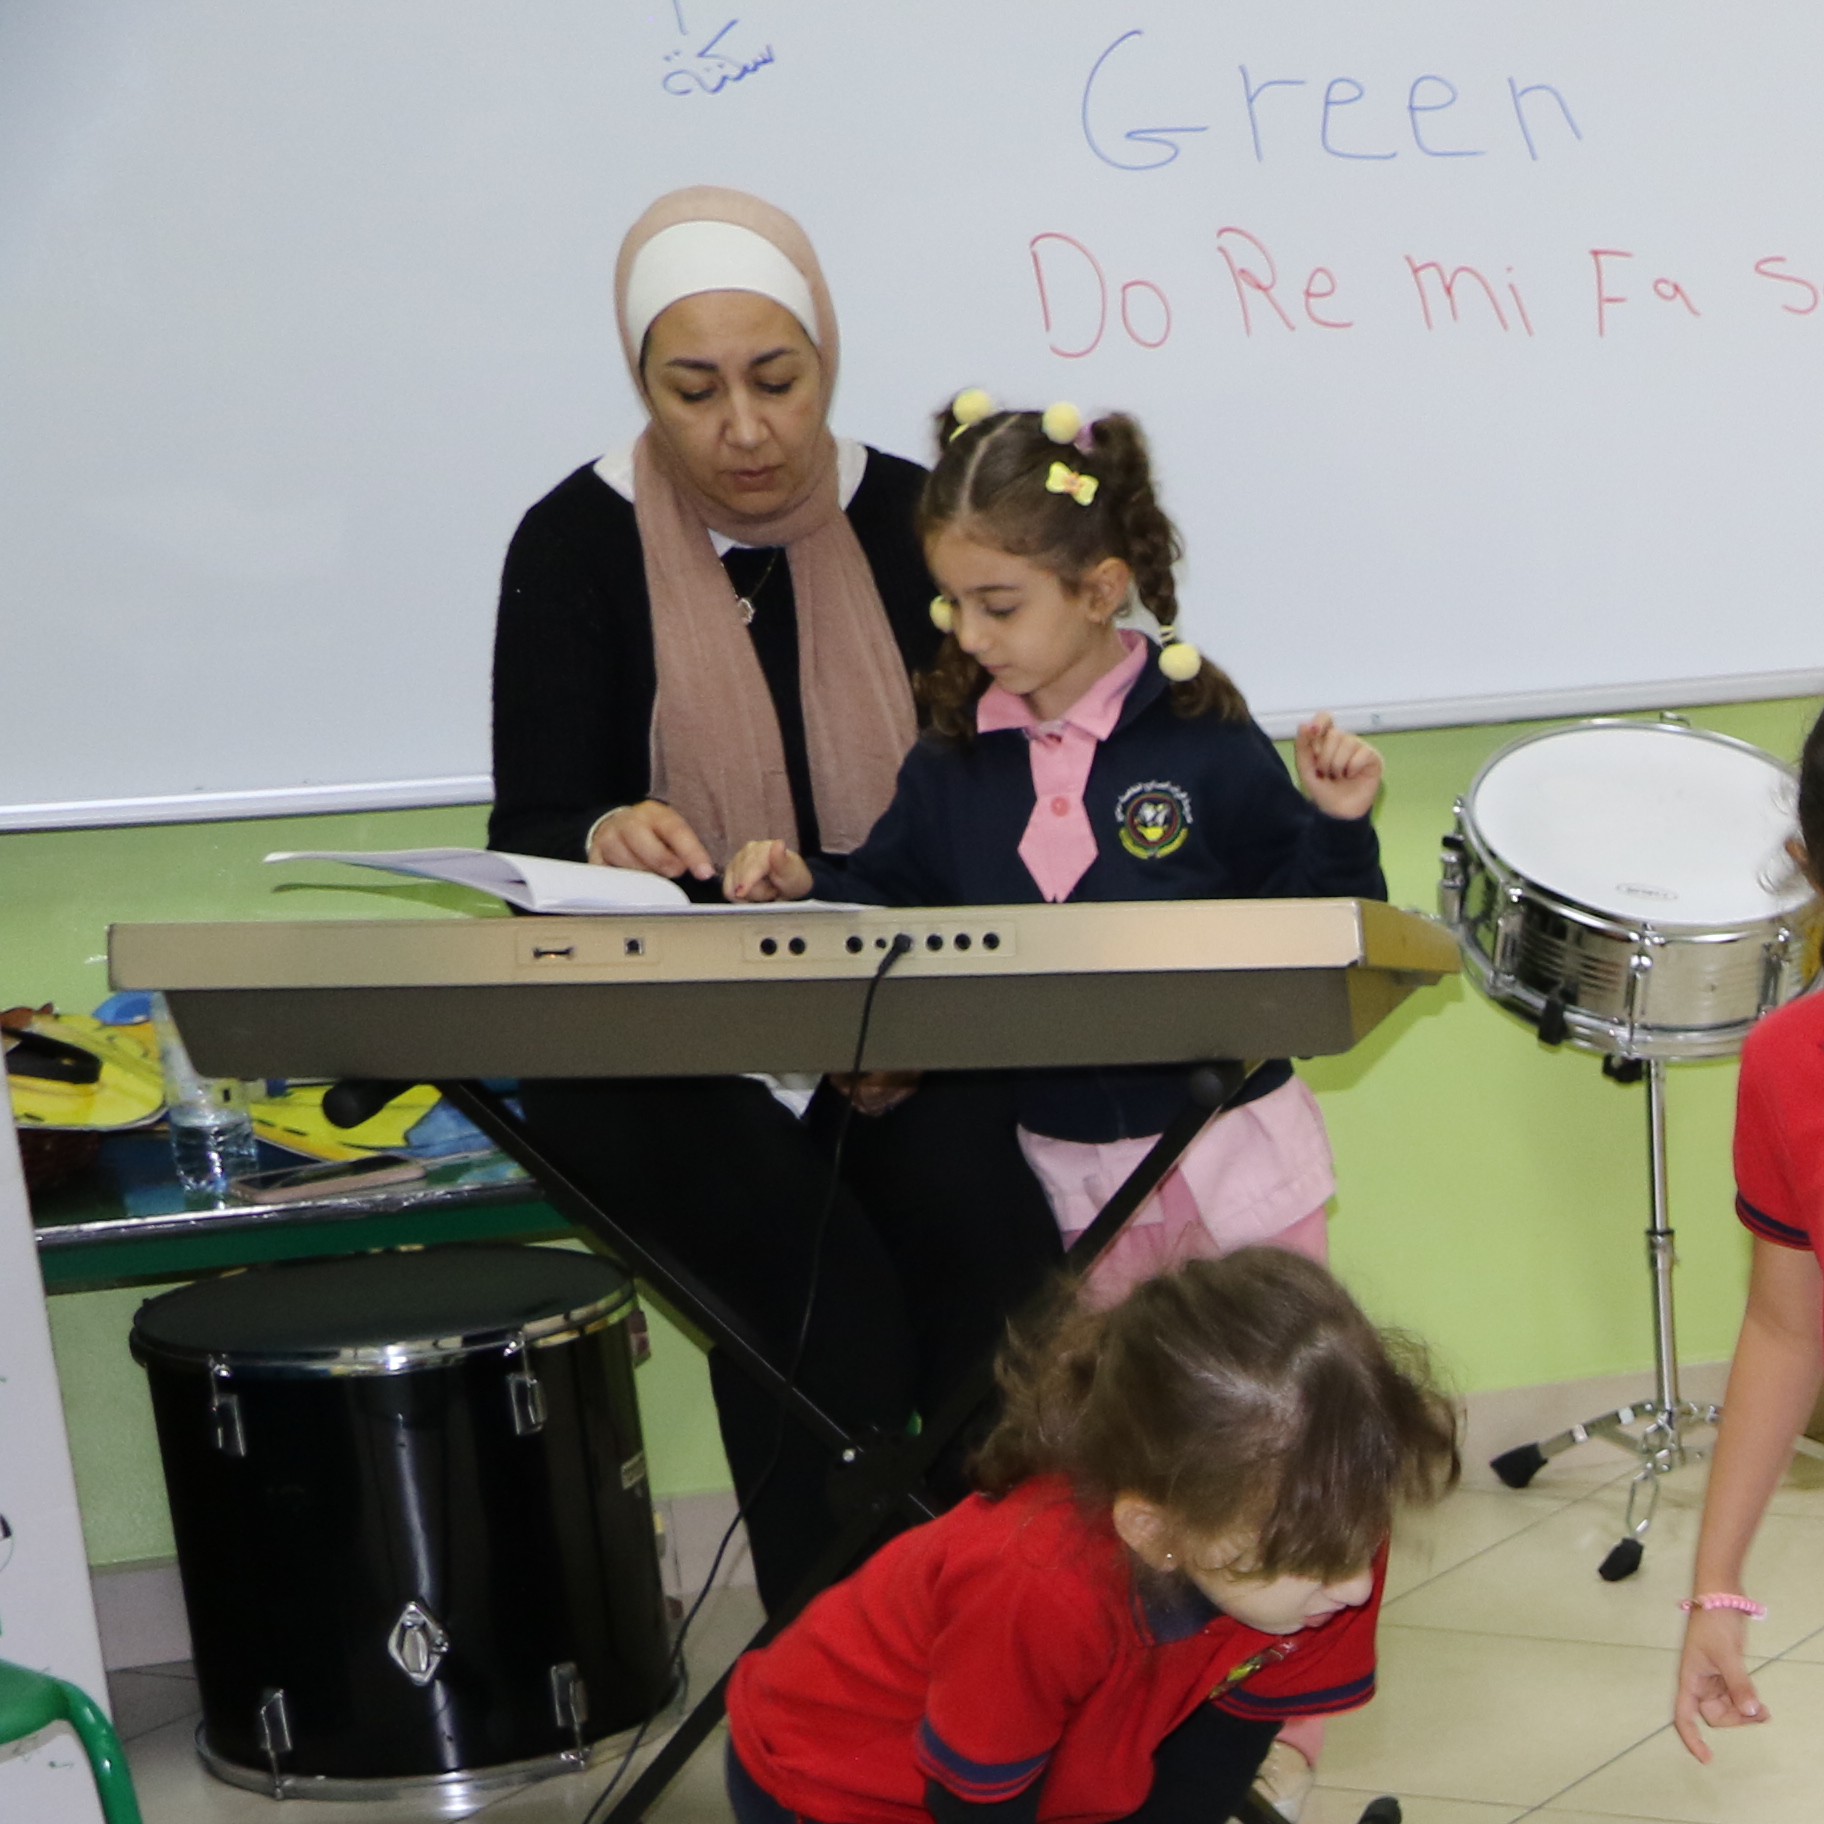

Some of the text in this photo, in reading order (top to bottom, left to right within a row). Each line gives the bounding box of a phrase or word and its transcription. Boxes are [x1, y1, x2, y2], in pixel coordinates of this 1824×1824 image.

[1081, 29, 1582, 171] Green
[1029, 231, 1172, 358] Do
[1216, 226, 1355, 338] Re
[1589, 248, 1701, 338] Fa
